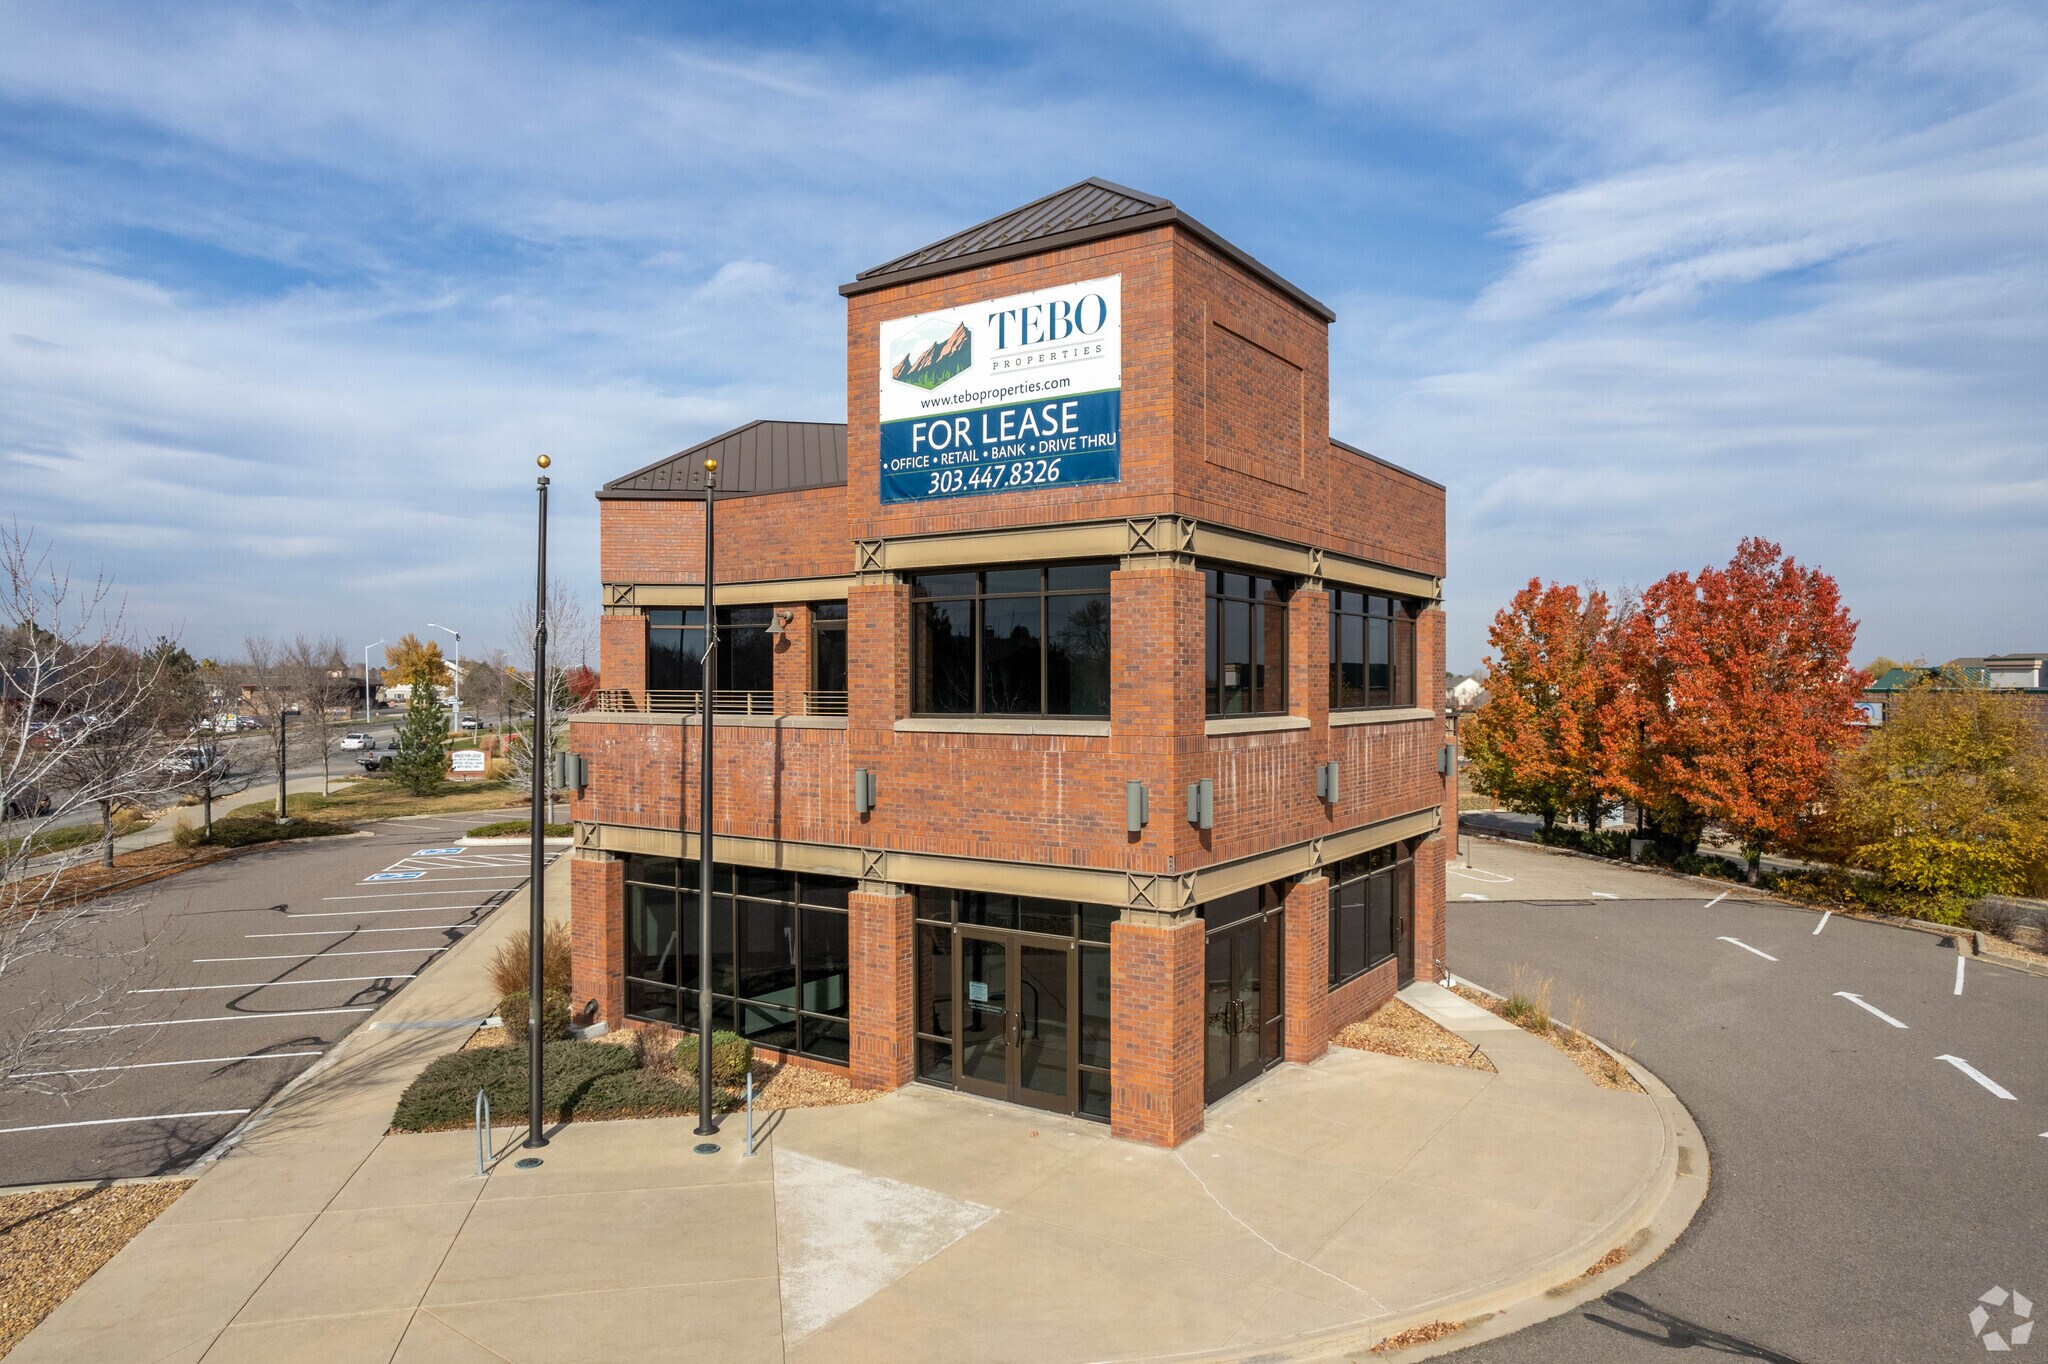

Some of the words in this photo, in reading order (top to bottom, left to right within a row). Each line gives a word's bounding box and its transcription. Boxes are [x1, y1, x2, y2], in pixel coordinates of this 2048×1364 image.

[988, 293, 1108, 351] TEBO
[992, 344, 1103, 370] PROPERTIES
[920, 377, 1071, 409] www.teboproperties.com
[912, 416, 973, 453] FOR
[982, 400, 1080, 444] LEASE
[891, 455, 930, 471] OFFICE
[941, 449, 980, 465] RETAIL
[991, 443, 1026, 459] BANK
[1038, 436, 1077, 454] DRIVE
[1079, 432, 1117, 449] THRU
[927, 457, 1062, 495] 303.447.8326
